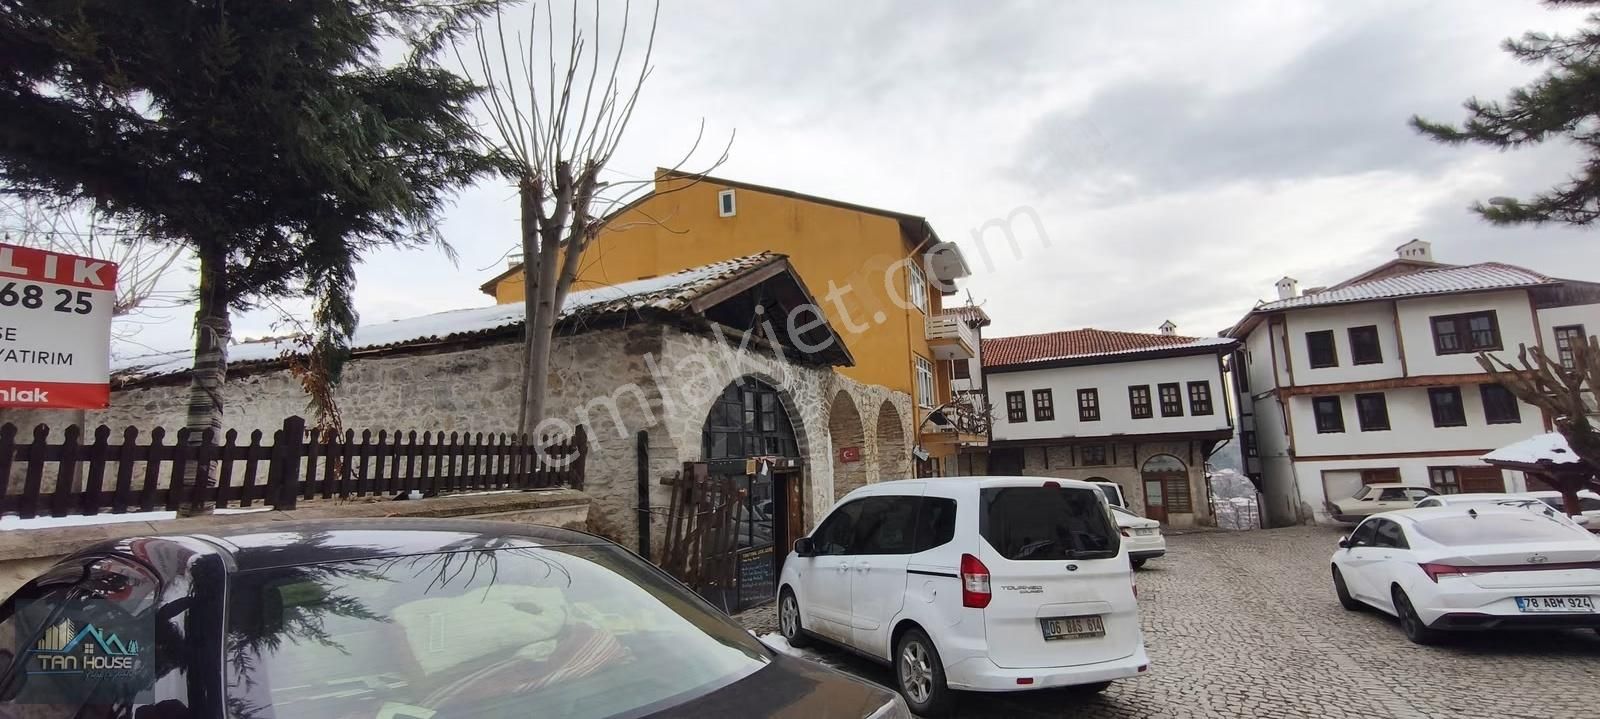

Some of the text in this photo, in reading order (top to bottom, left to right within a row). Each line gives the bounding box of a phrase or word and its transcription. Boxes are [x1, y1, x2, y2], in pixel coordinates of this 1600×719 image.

[0, 247, 106, 286] LIK
[0, 282, 93, 315] 68 25
[1525, 597, 1591, 608] 78 ABM 924
[1050, 621, 1062, 634] 06
[1086, 618, 1102, 631] 614
